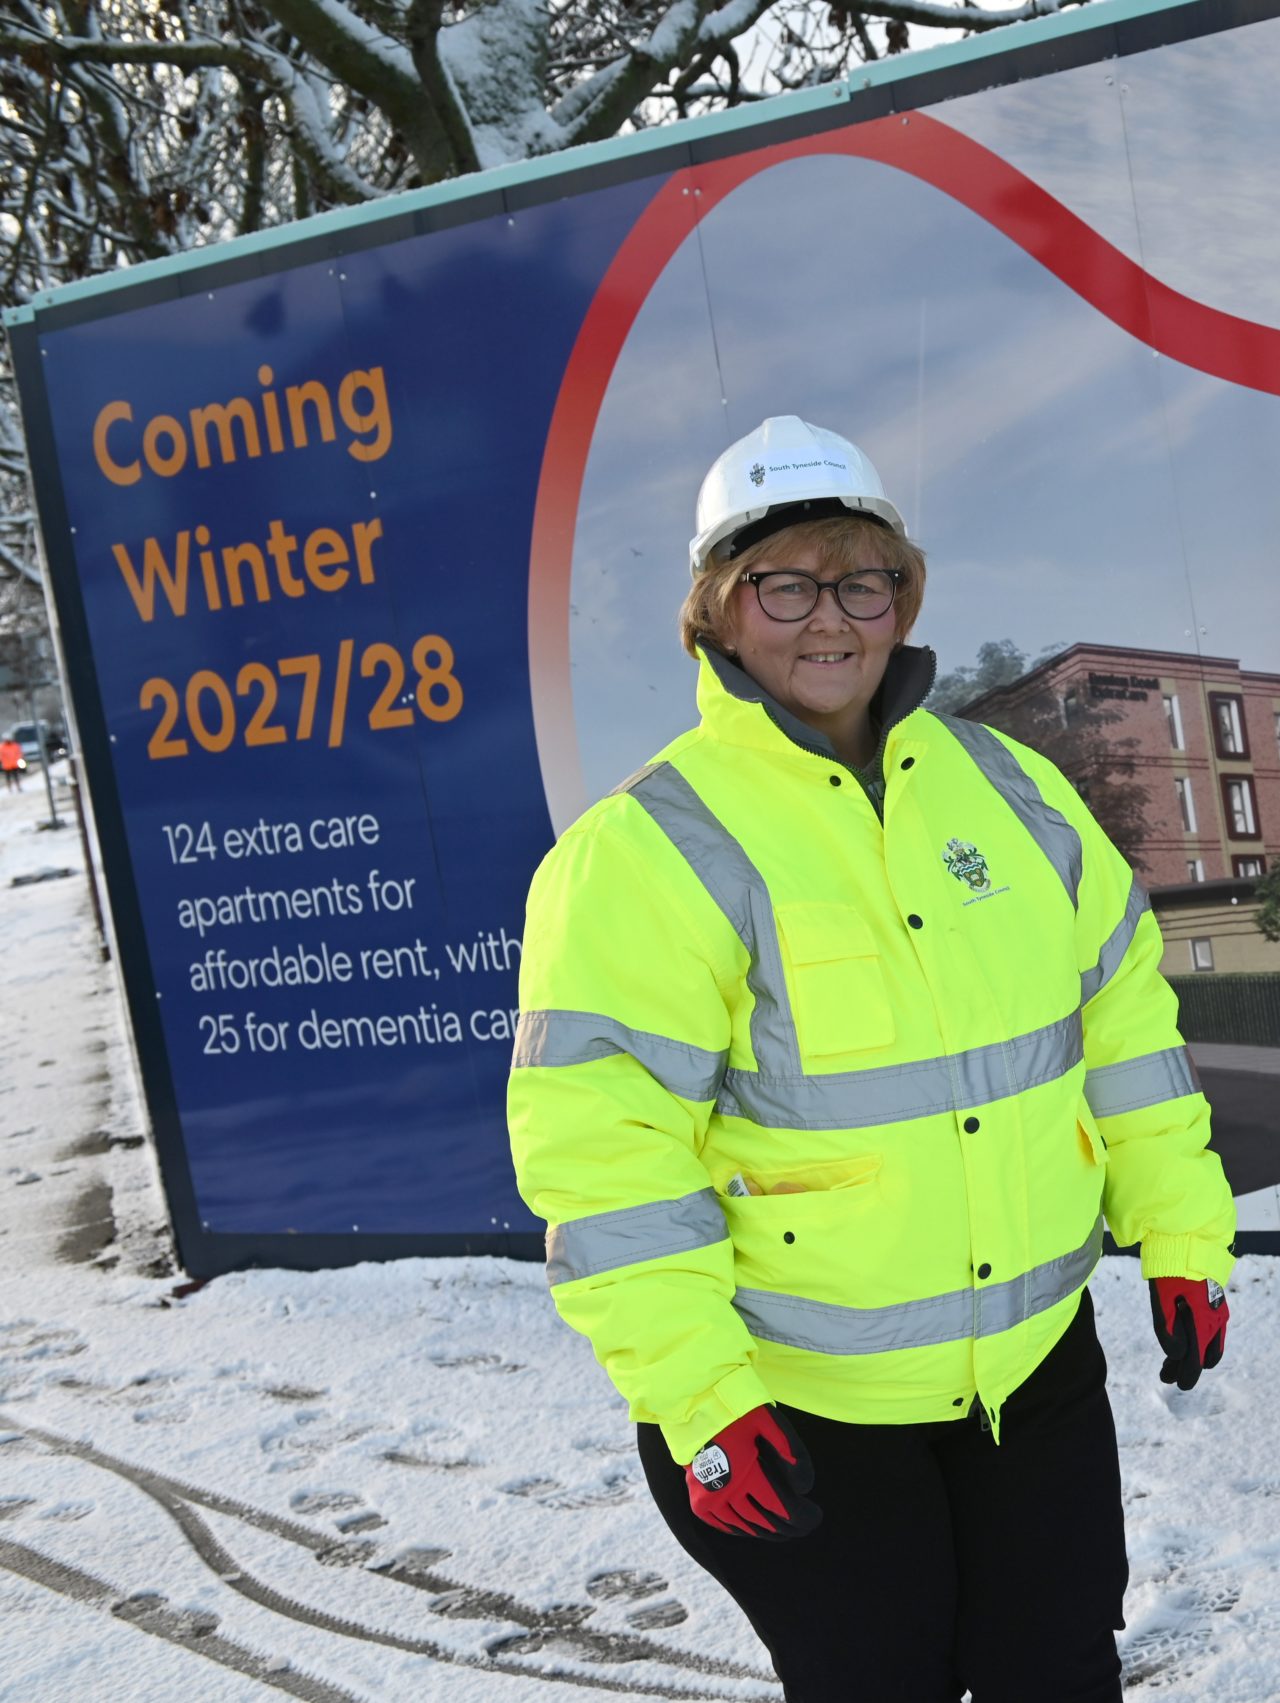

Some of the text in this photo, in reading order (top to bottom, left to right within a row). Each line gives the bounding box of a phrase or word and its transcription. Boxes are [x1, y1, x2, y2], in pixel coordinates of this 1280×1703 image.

[93, 364, 393, 486] Coming
[792, 460, 822, 471] Tyneside
[823, 459, 847, 470] Council
[111, 518, 384, 623] Winter
[139, 634, 464, 761] 2027/28
[162, 813, 380, 865] 124 extra care
[177, 869, 416, 938] apartments for
[189, 927, 522, 992] affordable rent, with
[198, 1003, 520, 1055] 25 for dementia car
